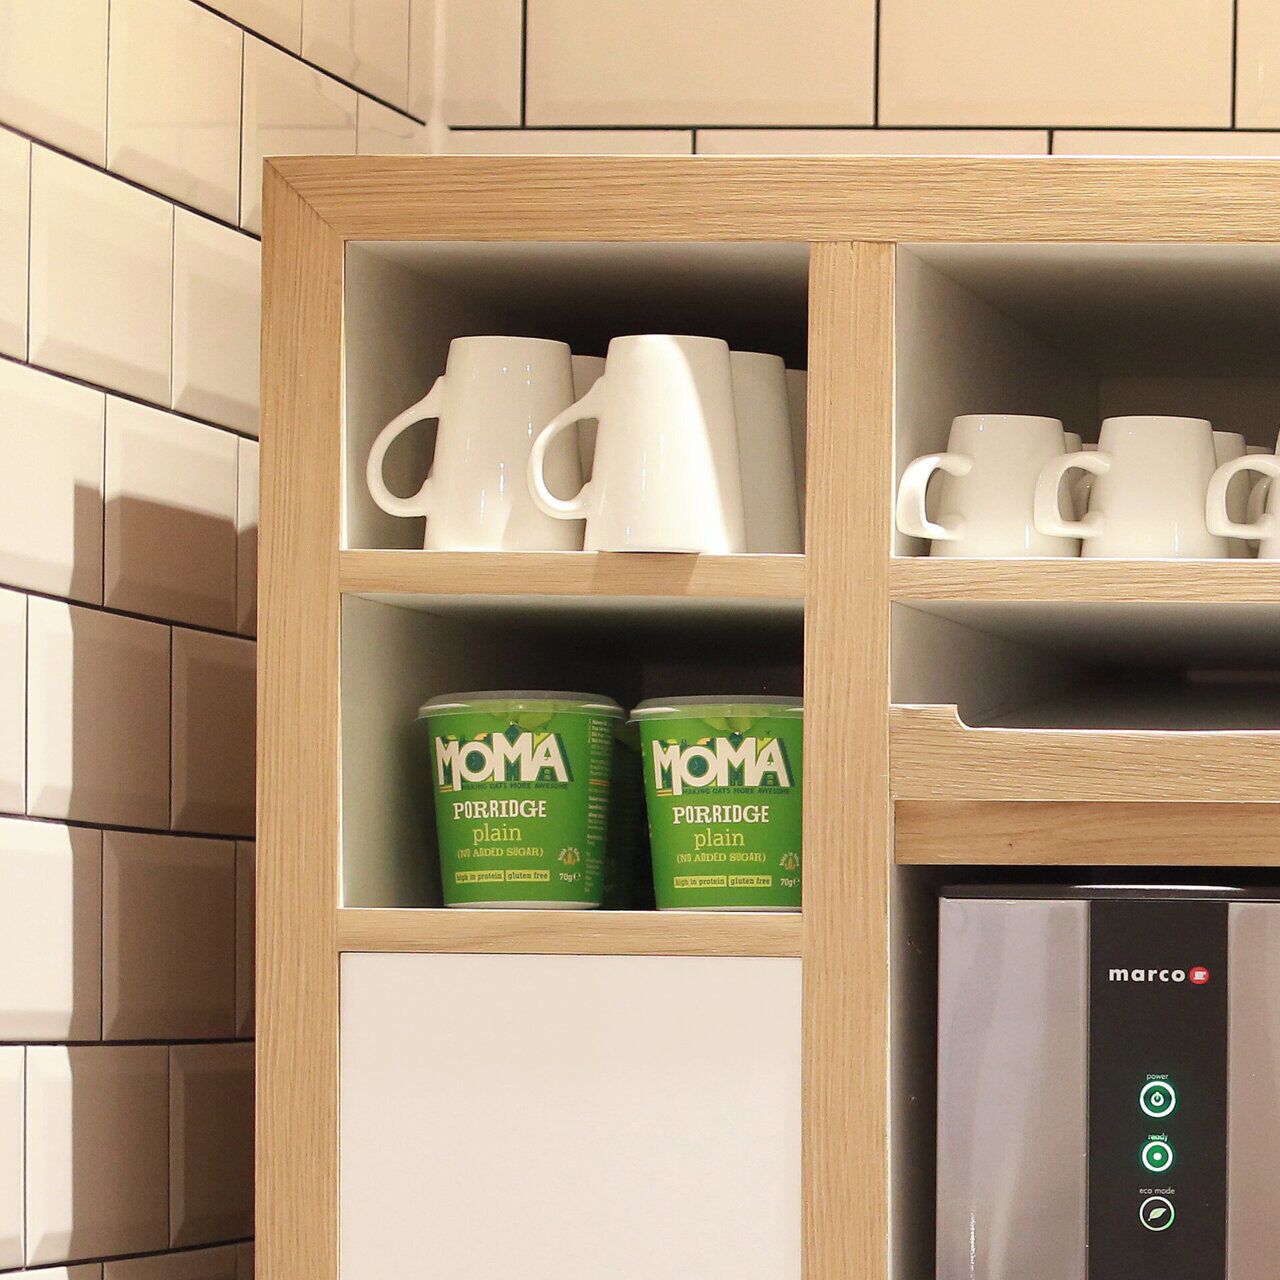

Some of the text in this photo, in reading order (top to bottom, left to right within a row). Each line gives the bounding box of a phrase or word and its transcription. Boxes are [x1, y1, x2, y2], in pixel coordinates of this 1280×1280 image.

[435, 733, 569, 791] MOMA
[652, 737, 790, 796] MOMA
[489, 782, 507, 790] OATS
[510, 782, 531, 790] MORE
[453, 800, 547, 820] PORRIDGE
[672, 805, 769, 825] PORRIDGE
[472, 823, 522, 845] plain
[693, 828, 745, 851] plain
[473, 847, 504, 858] ADDED
[506, 846, 544, 857] SUGAR)
[694, 852, 727, 863] ADDED
[729, 852, 767, 863] SUGAR)
[457, 873, 469, 882] high
[477, 872, 502, 882] protein
[507, 871, 548, 881] gluten free
[730, 876, 770, 886] gluten free
[675, 878, 689, 887] high
[699, 877, 725, 886] protein
[1108, 967, 1186, 983] marco
[1146, 1073, 1169, 1081] power
[1148, 1133, 1168, 1143] ready
[1154, 1187, 1175, 1195] mode
